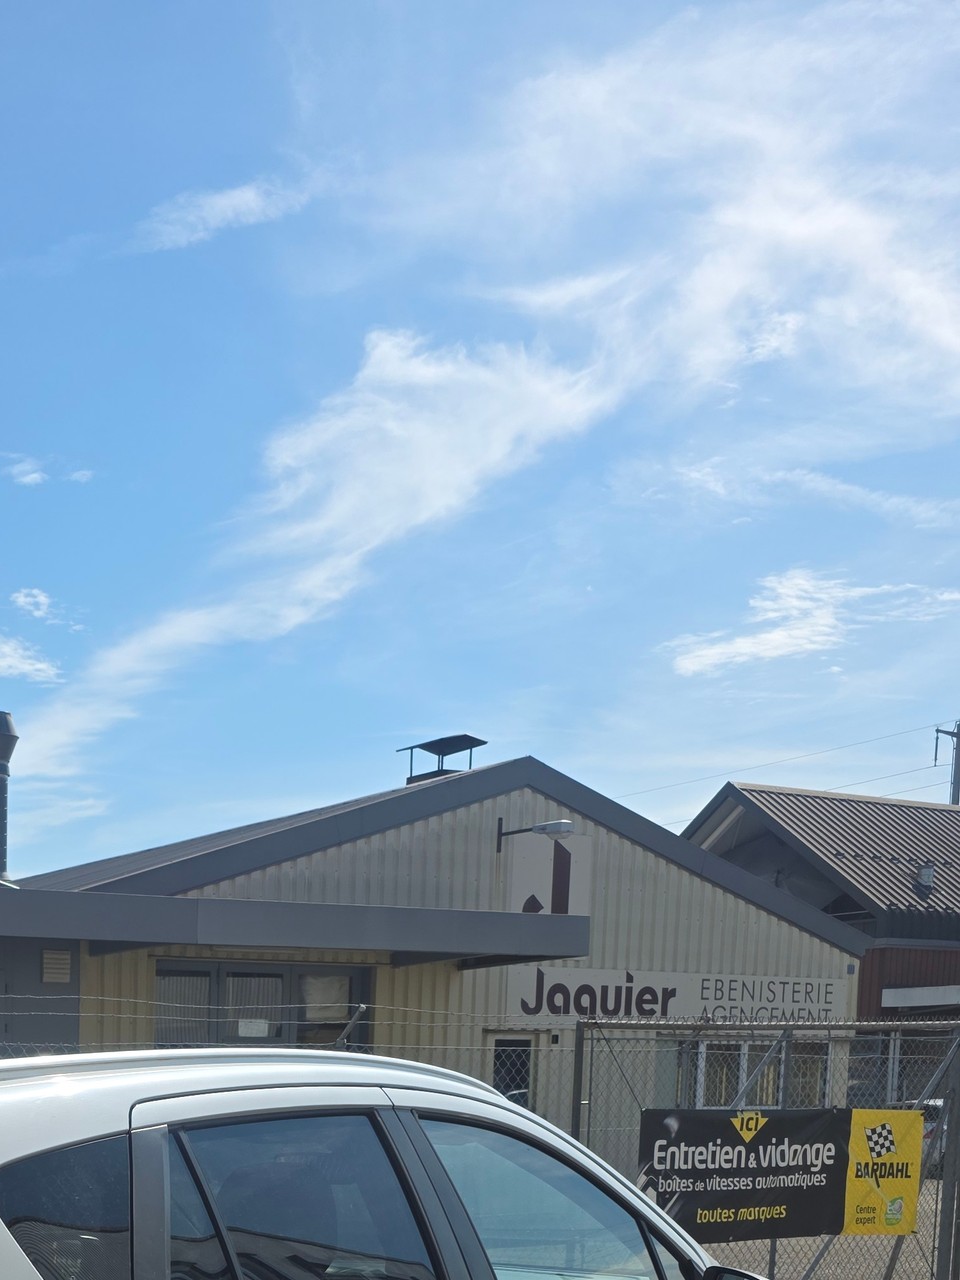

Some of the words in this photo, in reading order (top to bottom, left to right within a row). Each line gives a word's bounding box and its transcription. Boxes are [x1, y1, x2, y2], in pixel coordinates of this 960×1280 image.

[521, 967, 677, 1018] Jaquier
[700, 978, 834, 1004] EBENISTERIE
[740, 1113, 759, 1132] ici
[653, 1138, 746, 1170] Entretien
[748, 1152, 757, 1168] &
[759, 1137, 835, 1171] vidange
[855, 1162, 911, 1180] BARDAHL
[658, 1175, 693, 1192] boîtes
[694, 1181, 704, 1191] de
[706, 1174, 753, 1191] vitesses
[755, 1171, 827, 1190] automatiques
[696, 1207, 735, 1223] toutes
[737, 1205, 787, 1223] marques
[856, 1205, 876, 1214] Centre
[855, 1216, 876, 1225] expert
